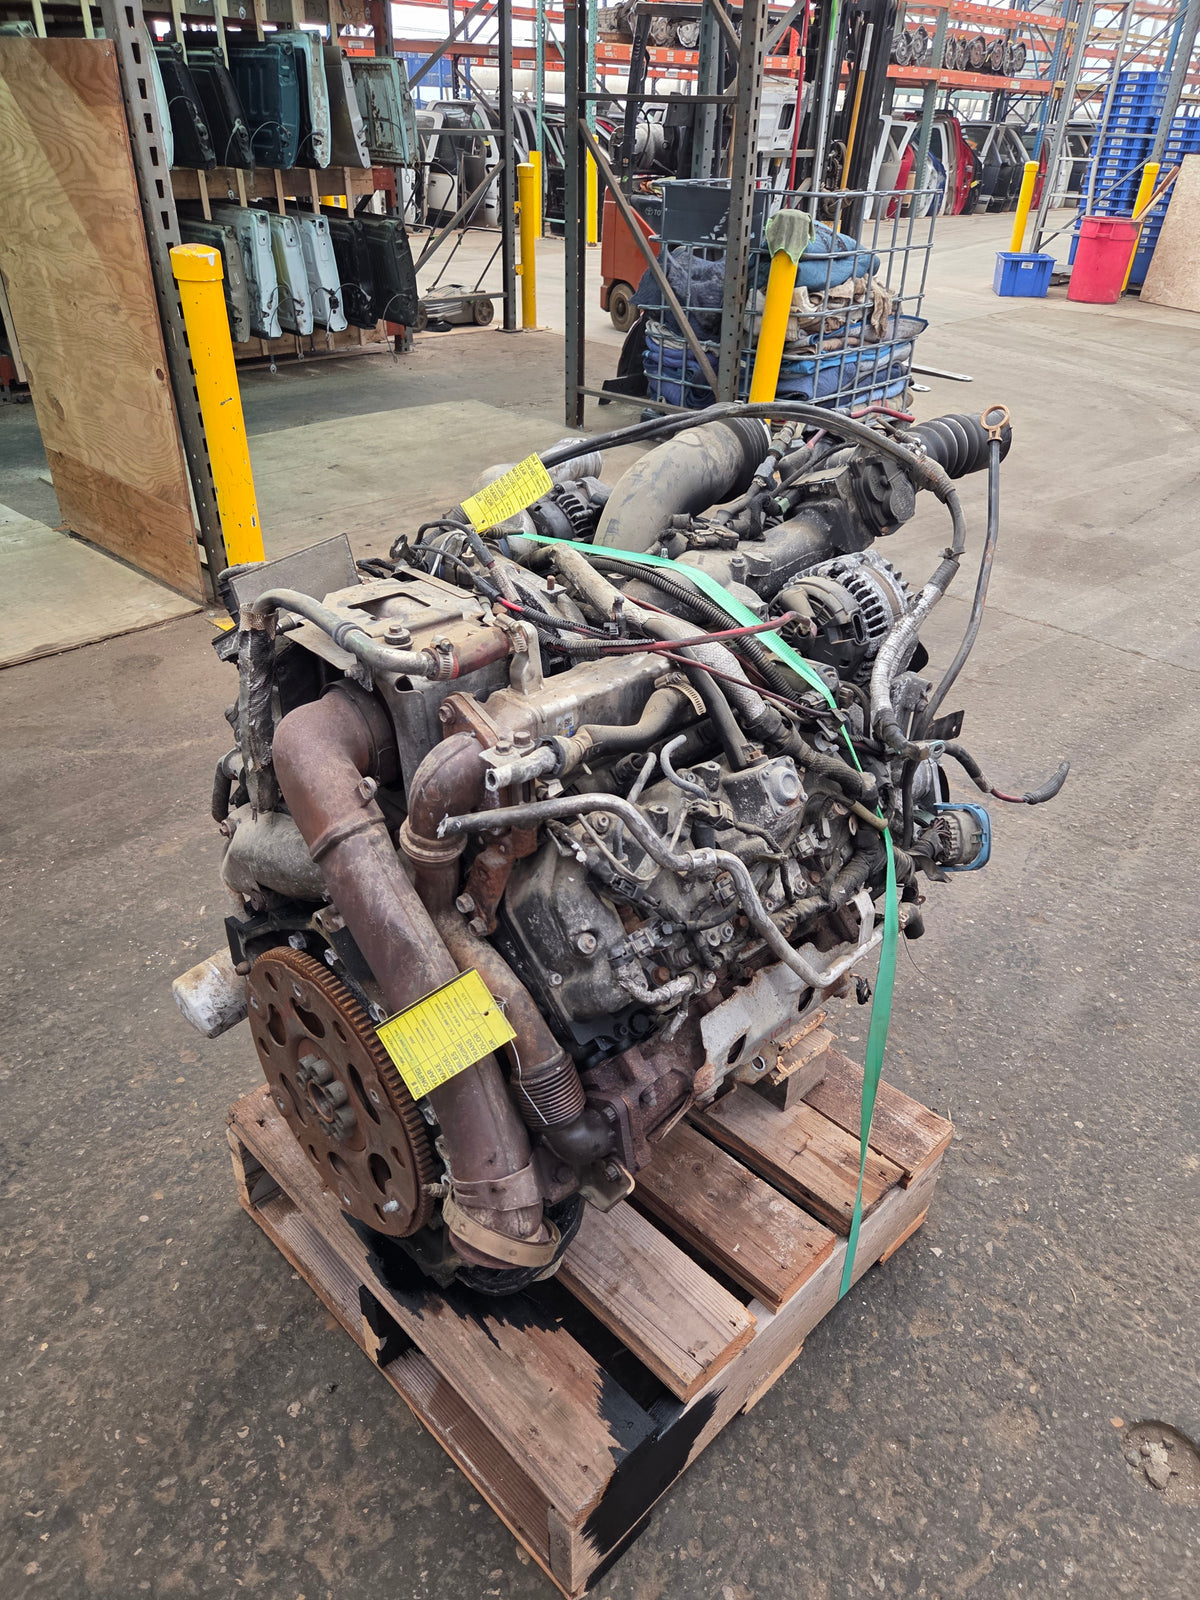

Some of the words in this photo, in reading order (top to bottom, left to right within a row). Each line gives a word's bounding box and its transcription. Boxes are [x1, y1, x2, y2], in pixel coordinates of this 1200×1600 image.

[511, 467, 521, 481] MAKE
[517, 463, 526, 475] YEAR
[523, 458, 535, 476] CONFIG
[493, 480, 505, 498] ENGINE
[499, 476, 509, 491] MILES
[505, 472, 516, 488] MODEL
[481, 489, 493, 507] COLOR
[487, 485, 498, 502] TRANS
[465, 1038, 480, 1059] TRANS
[472, 1031, 489, 1054] COLOR
[488, 1038, 497, 1048] GR
[450, 1050, 464, 1069] MILES
[455, 1040, 472, 1064] ENGINE
[434, 1062, 447, 1080] MAKE
[440, 1053, 456, 1075] MODEL
[414, 1067, 431, 1091] CONFIG
[426, 1068, 439, 1086] YEAR
[413, 1085, 422, 1097] VIN
